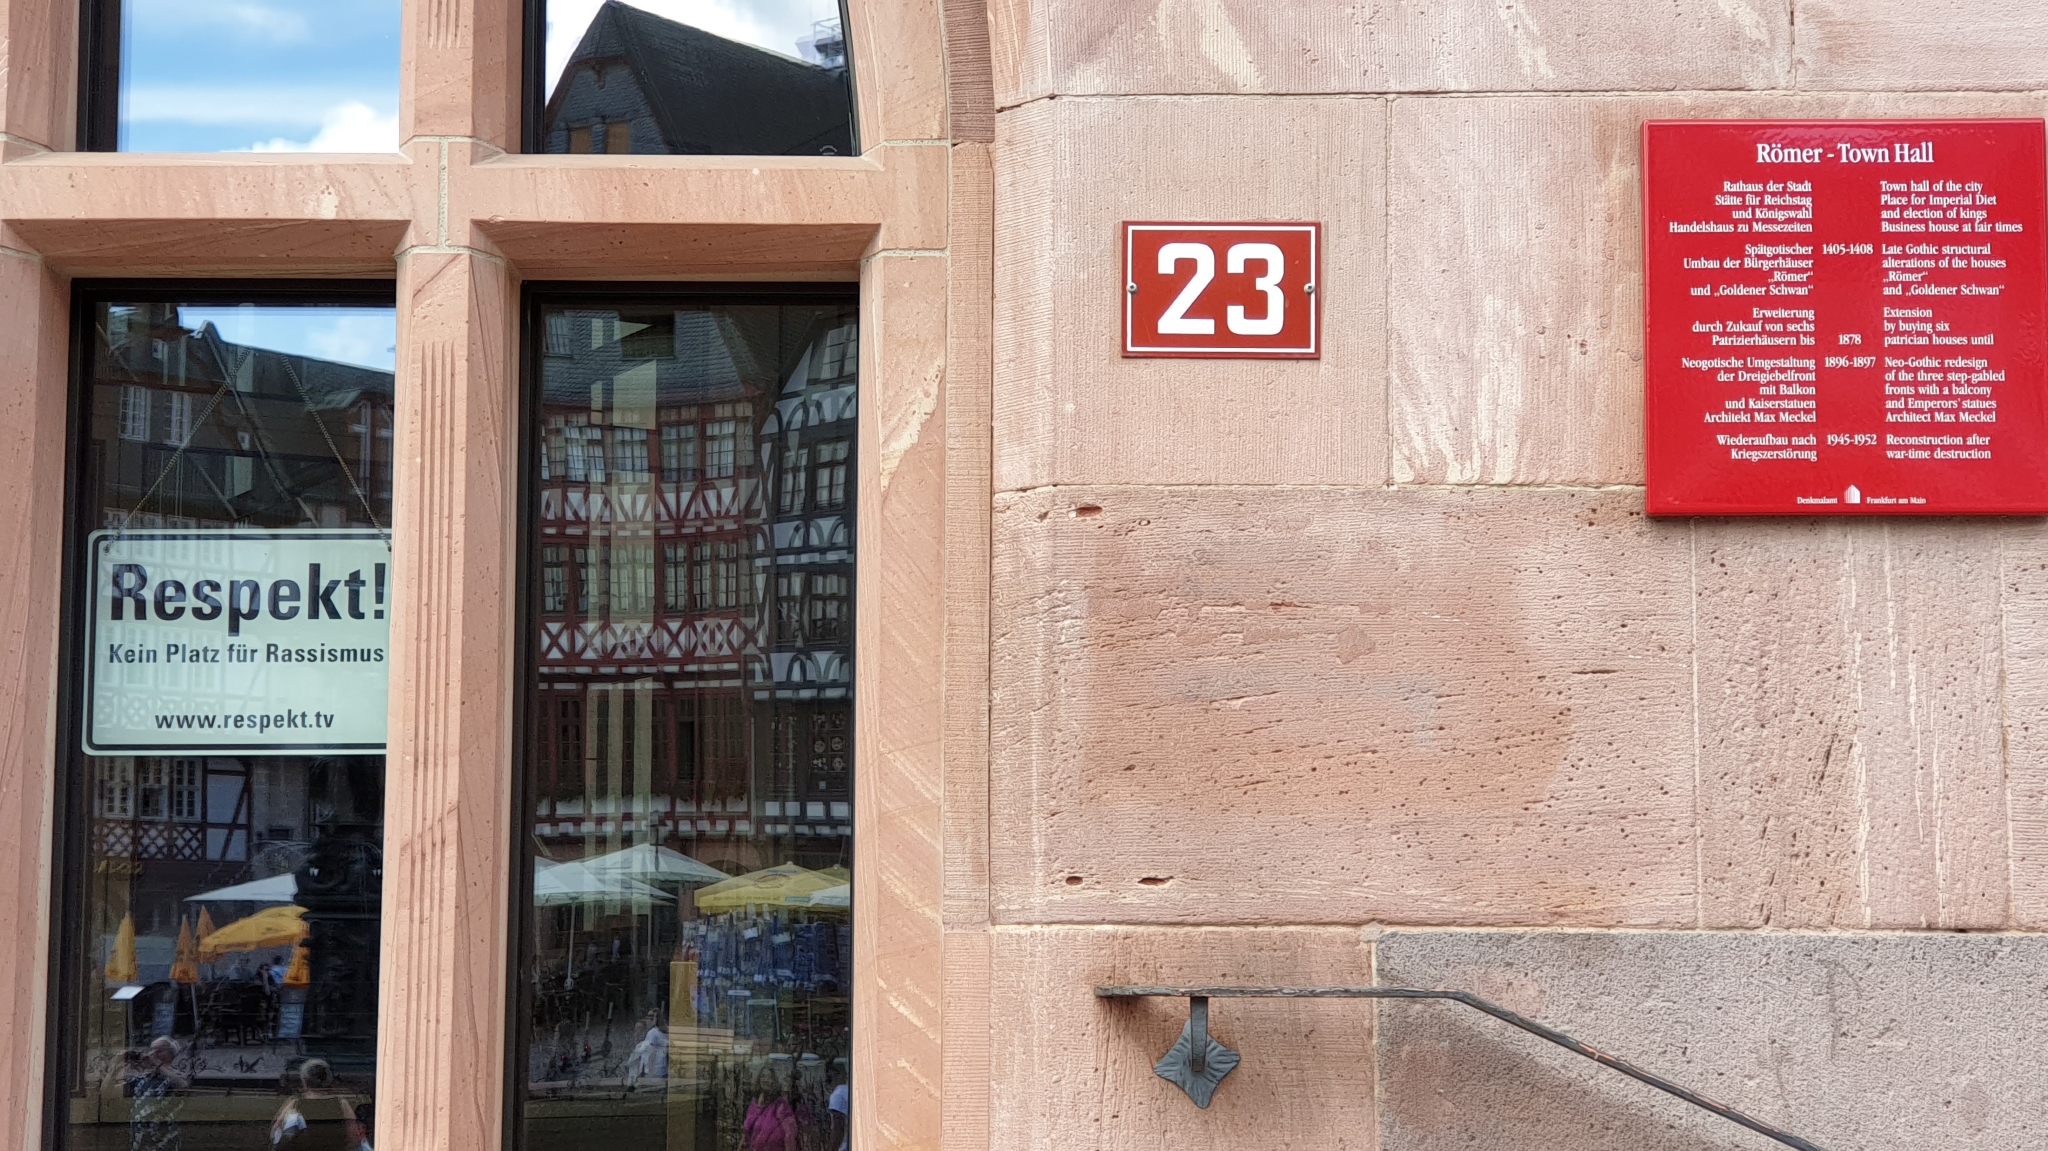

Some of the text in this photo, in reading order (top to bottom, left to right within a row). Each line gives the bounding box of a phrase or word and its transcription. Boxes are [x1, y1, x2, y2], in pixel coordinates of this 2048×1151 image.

[1756, 143, 1823, 163] Römer
[1837, 143, 1890, 163] Town
[1894, 142, 1934, 163] Hall
[1724, 180, 1812, 192] Rathaus der Stadt
[1880, 179, 1983, 194] Town hall of the city
[1715, 193, 1812, 208] Stätte für Reichstag
[1881, 193, 1997, 208] Place for Imperial Diet
[1732, 206, 1812, 222] und Königswahl
[1881, 206, 1987, 222] and election of kings
[1670, 221, 1812, 233] Handelshaus zu Messezeiten
[1882, 220, 2023, 232] Business house at fair times
[1745, 243, 1813, 258] Spätgotischer
[1823, 244, 1873, 255] 1405-1408
[1882, 243, 1991, 254] Late Gothic structural
[1684, 256, 1814, 271] Umbau der Bürgerhäuser
[1882, 256, 2006, 268] alterations of the houses
[1158, 242, 1284, 335] 23
[1691, 284, 1711, 296] und
[1883, 283, 1902, 295] and
[1753, 307, 1815, 321] Erweiterung
[1884, 307, 1932, 317] Extension
[1692, 320, 1815, 332] durch Zukauf von sechs
[1884, 319, 1950, 334] by buying six
[1712, 333, 1815, 345] Patrizierhäusern bis
[1839, 334, 1862, 345] 1878
[1884, 333, 1994, 347] patrician houses until
[1682, 356, 1816, 371] Neogotische Umgestaltung
[1825, 356, 1876, 368] 1896-1897
[1885, 355, 1988, 371] Neo-Gothic redesign
[1717, 370, 1816, 385] der Dreigiebelfront
[1885, 369, 2005, 384] of the three step-gabled
[1760, 383, 1816, 395] mit Balkon
[1885, 383, 1992, 398] fronts with a balcony
[1725, 397, 1816, 409] und Kaiserstatuen
[1885, 396, 1905, 409] and
[1962, 399, 1997, 409] statues
[1704, 410, 1816, 423] Architekt Max Meckel
[1886, 410, 1996, 422] Architect Max Meckel
[1717, 433, 1816, 445] Wiederaufbau nach
[1827, 434, 1877, 445] 1945-1952
[1887, 433, 1990, 445] Reconstruction after
[1731, 448, 1817, 462] Kriegszerstörung
[1886, 447, 1991, 459] war-time destruction
[110, 562, 386, 637] Respekt!
[109, 642, 384, 664] Kein Platz für Rassismus
[155, 709, 335, 734] www.respekt.tv
